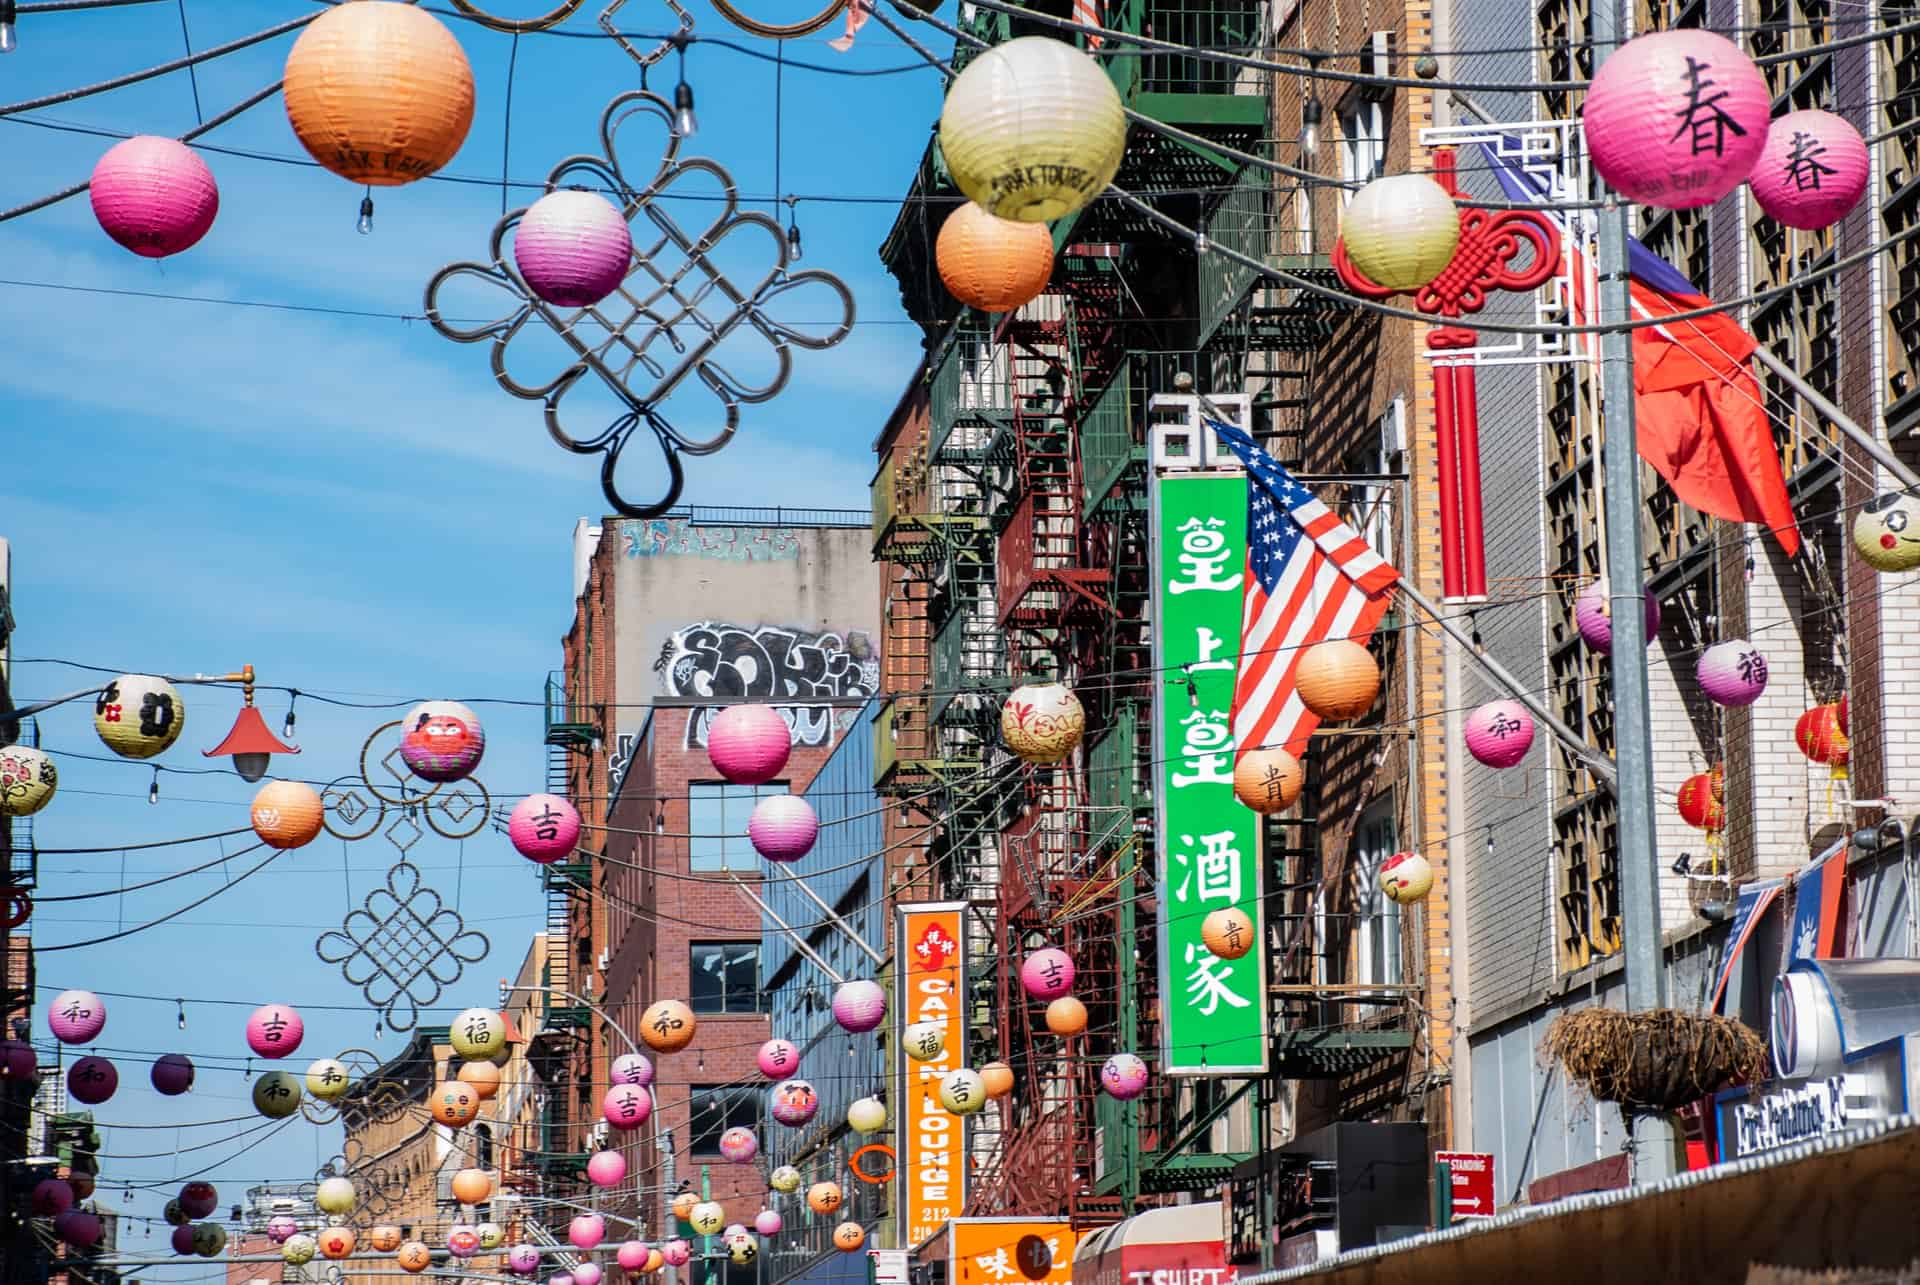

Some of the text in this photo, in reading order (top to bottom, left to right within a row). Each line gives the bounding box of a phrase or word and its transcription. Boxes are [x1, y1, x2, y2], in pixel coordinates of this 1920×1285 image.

[1669, 55, 1748, 158] 春
[1783, 131, 1839, 192] 春
[1737, 651, 1768, 685] 福
[1488, 711, 1521, 740] 和
[1258, 763, 1288, 801] 貴
[531, 803, 562, 840] 吉
[1223, 919, 1244, 951] 貴
[1039, 959, 1064, 989] 吉
[61, 1000, 91, 1024] 和
[653, 1010, 682, 1038] 和
[262, 1013, 288, 1043] 吉
[464, 1016, 490, 1046] 福
[770, 1041, 789, 1067] 吉
[918, 1031, 938, 1055] 福
[320, 1065, 342, 1087] 和
[623, 1062, 642, 1084] 吉
[263, 1081, 291, 1101] 和
[920, 979, 949, 1201] CANON LOUNGE
[950, 1076, 971, 1105] 吉
[617, 1091, 639, 1119] 吉
[820, 1192, 837, 1208] 和
[922, 1207, 950, 1222] 212
[699, 1213, 718, 1228] 和
